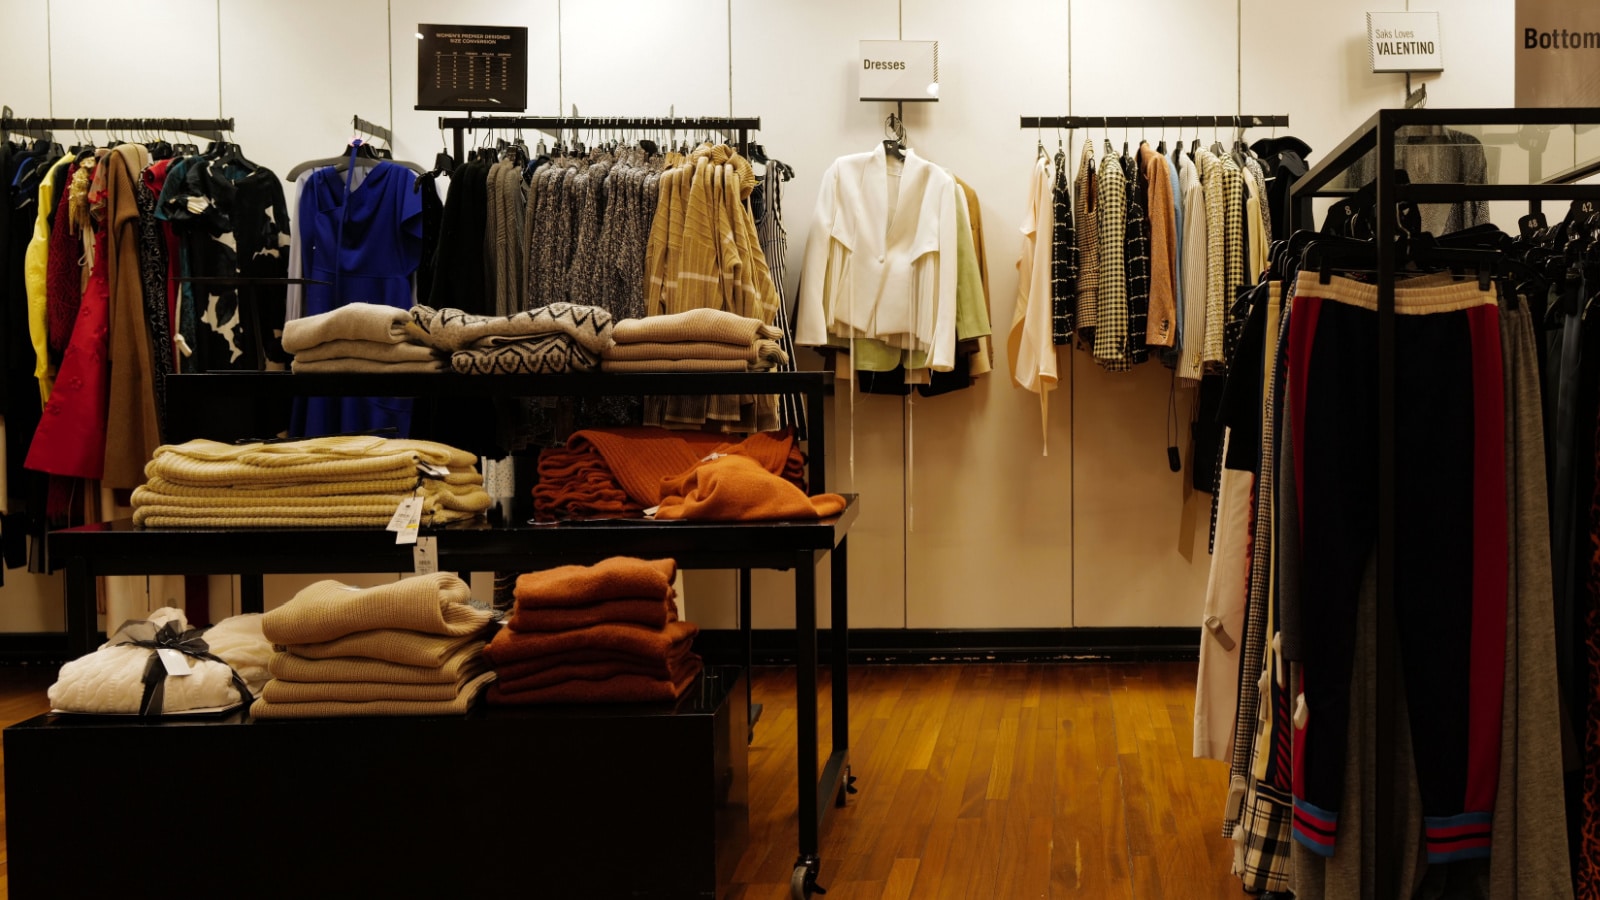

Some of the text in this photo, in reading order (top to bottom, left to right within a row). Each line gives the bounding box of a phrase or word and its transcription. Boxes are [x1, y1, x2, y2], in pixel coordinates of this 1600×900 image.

[1375, 28, 1414, 39] Saks Loves
[1524, 27, 1600, 49] Bottom
[1376, 41, 1435, 55] VALENTINO
[864, 59, 906, 70] Dresses
[1344, 204, 1352, 216] 8
[1581, 201, 1594, 213] 42
